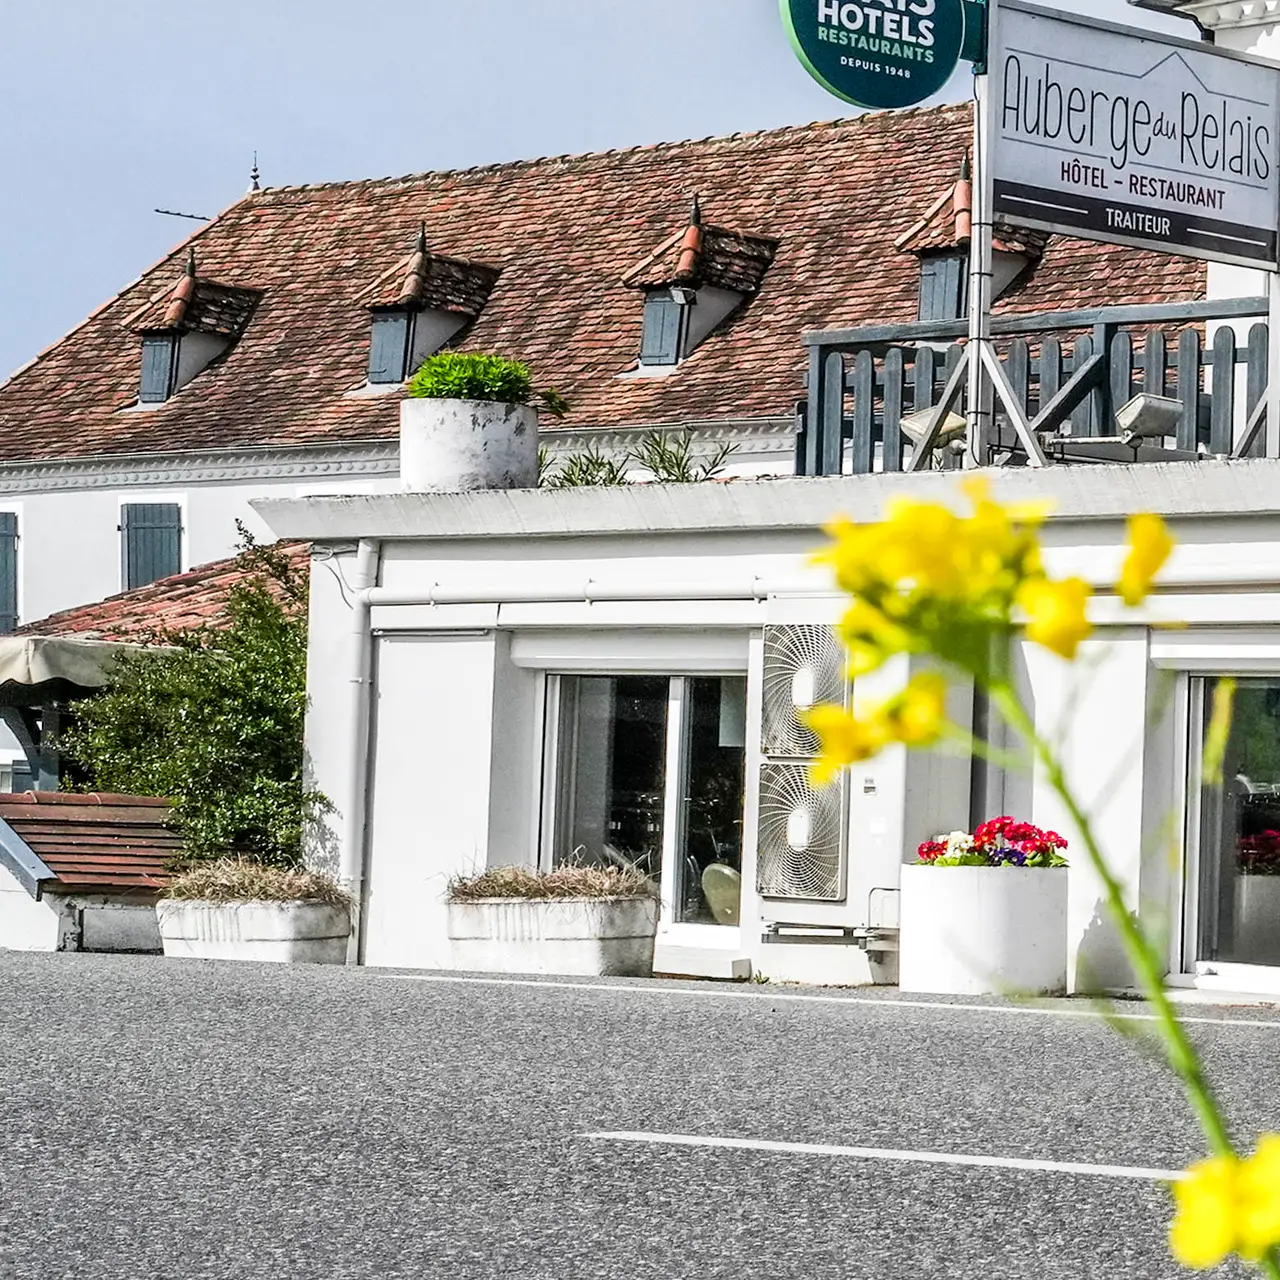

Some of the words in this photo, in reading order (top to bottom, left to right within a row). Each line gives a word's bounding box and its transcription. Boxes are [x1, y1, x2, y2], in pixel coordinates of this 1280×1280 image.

[818, 26, 934, 63] RESTAURANTS
[840, 56, 881, 73] DEPUIS
[885, 65, 911, 78] 1948
[1003, 55, 1151, 170] Auberge
[1153, 111, 1177, 140] du
[1181, 91, 1270, 180] Relais
[1061, 158, 1108, 190] HÔTEL
[1129, 174, 1225, 210] RESTAURANT
[1106, 208, 1171, 235] TRAITEUR
